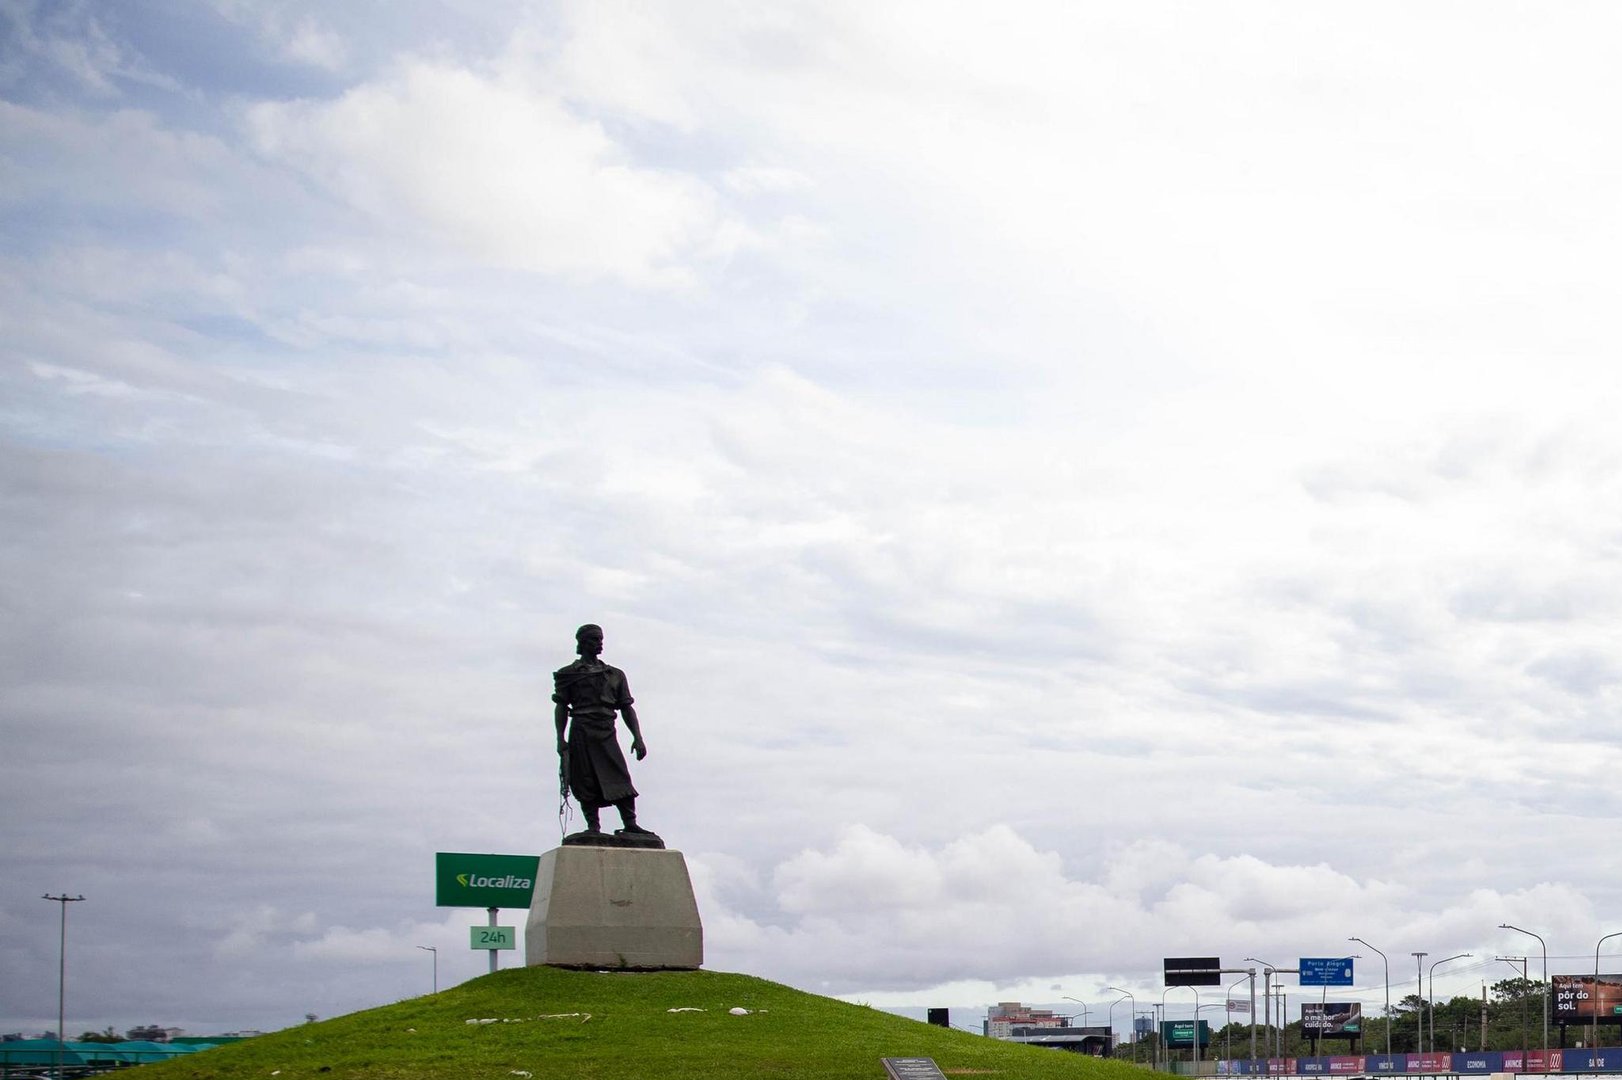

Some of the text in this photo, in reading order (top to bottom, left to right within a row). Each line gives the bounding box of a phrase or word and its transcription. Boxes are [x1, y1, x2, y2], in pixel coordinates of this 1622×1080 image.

[469, 874, 531, 889] Localiza
[480, 931, 506, 943] 24h
[1558, 990, 1589, 1002] pôr do
[1558, 1001, 1576, 1010] sol.
[1467, 1060, 1486, 1069] ECONOMIA
